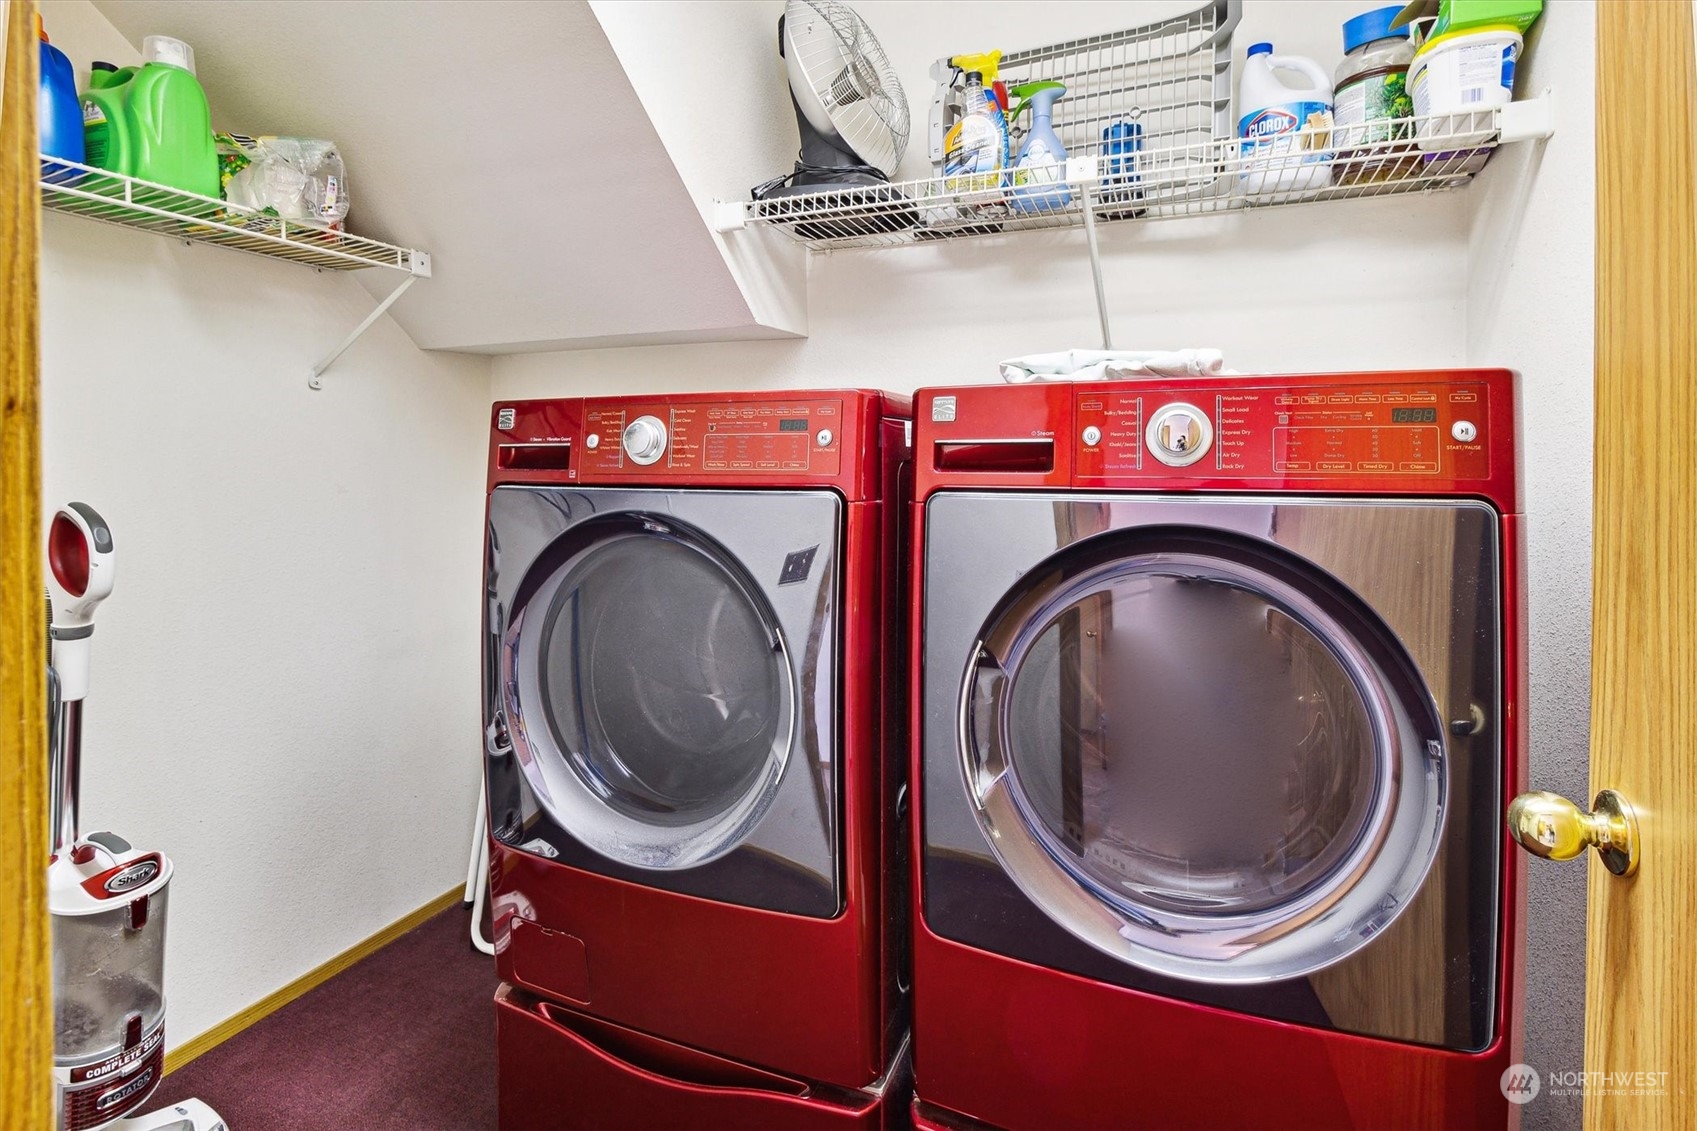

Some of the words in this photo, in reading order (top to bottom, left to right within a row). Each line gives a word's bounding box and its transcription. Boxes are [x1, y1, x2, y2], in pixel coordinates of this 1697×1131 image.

[1249, 116, 1290, 138] CLOROX
[118, 868, 149, 886] Shark
[86, 1050, 141, 1079] COMPLETE
[144, 1032, 160, 1052] SEAL
[106, 1074, 149, 1104] ROTATOR
